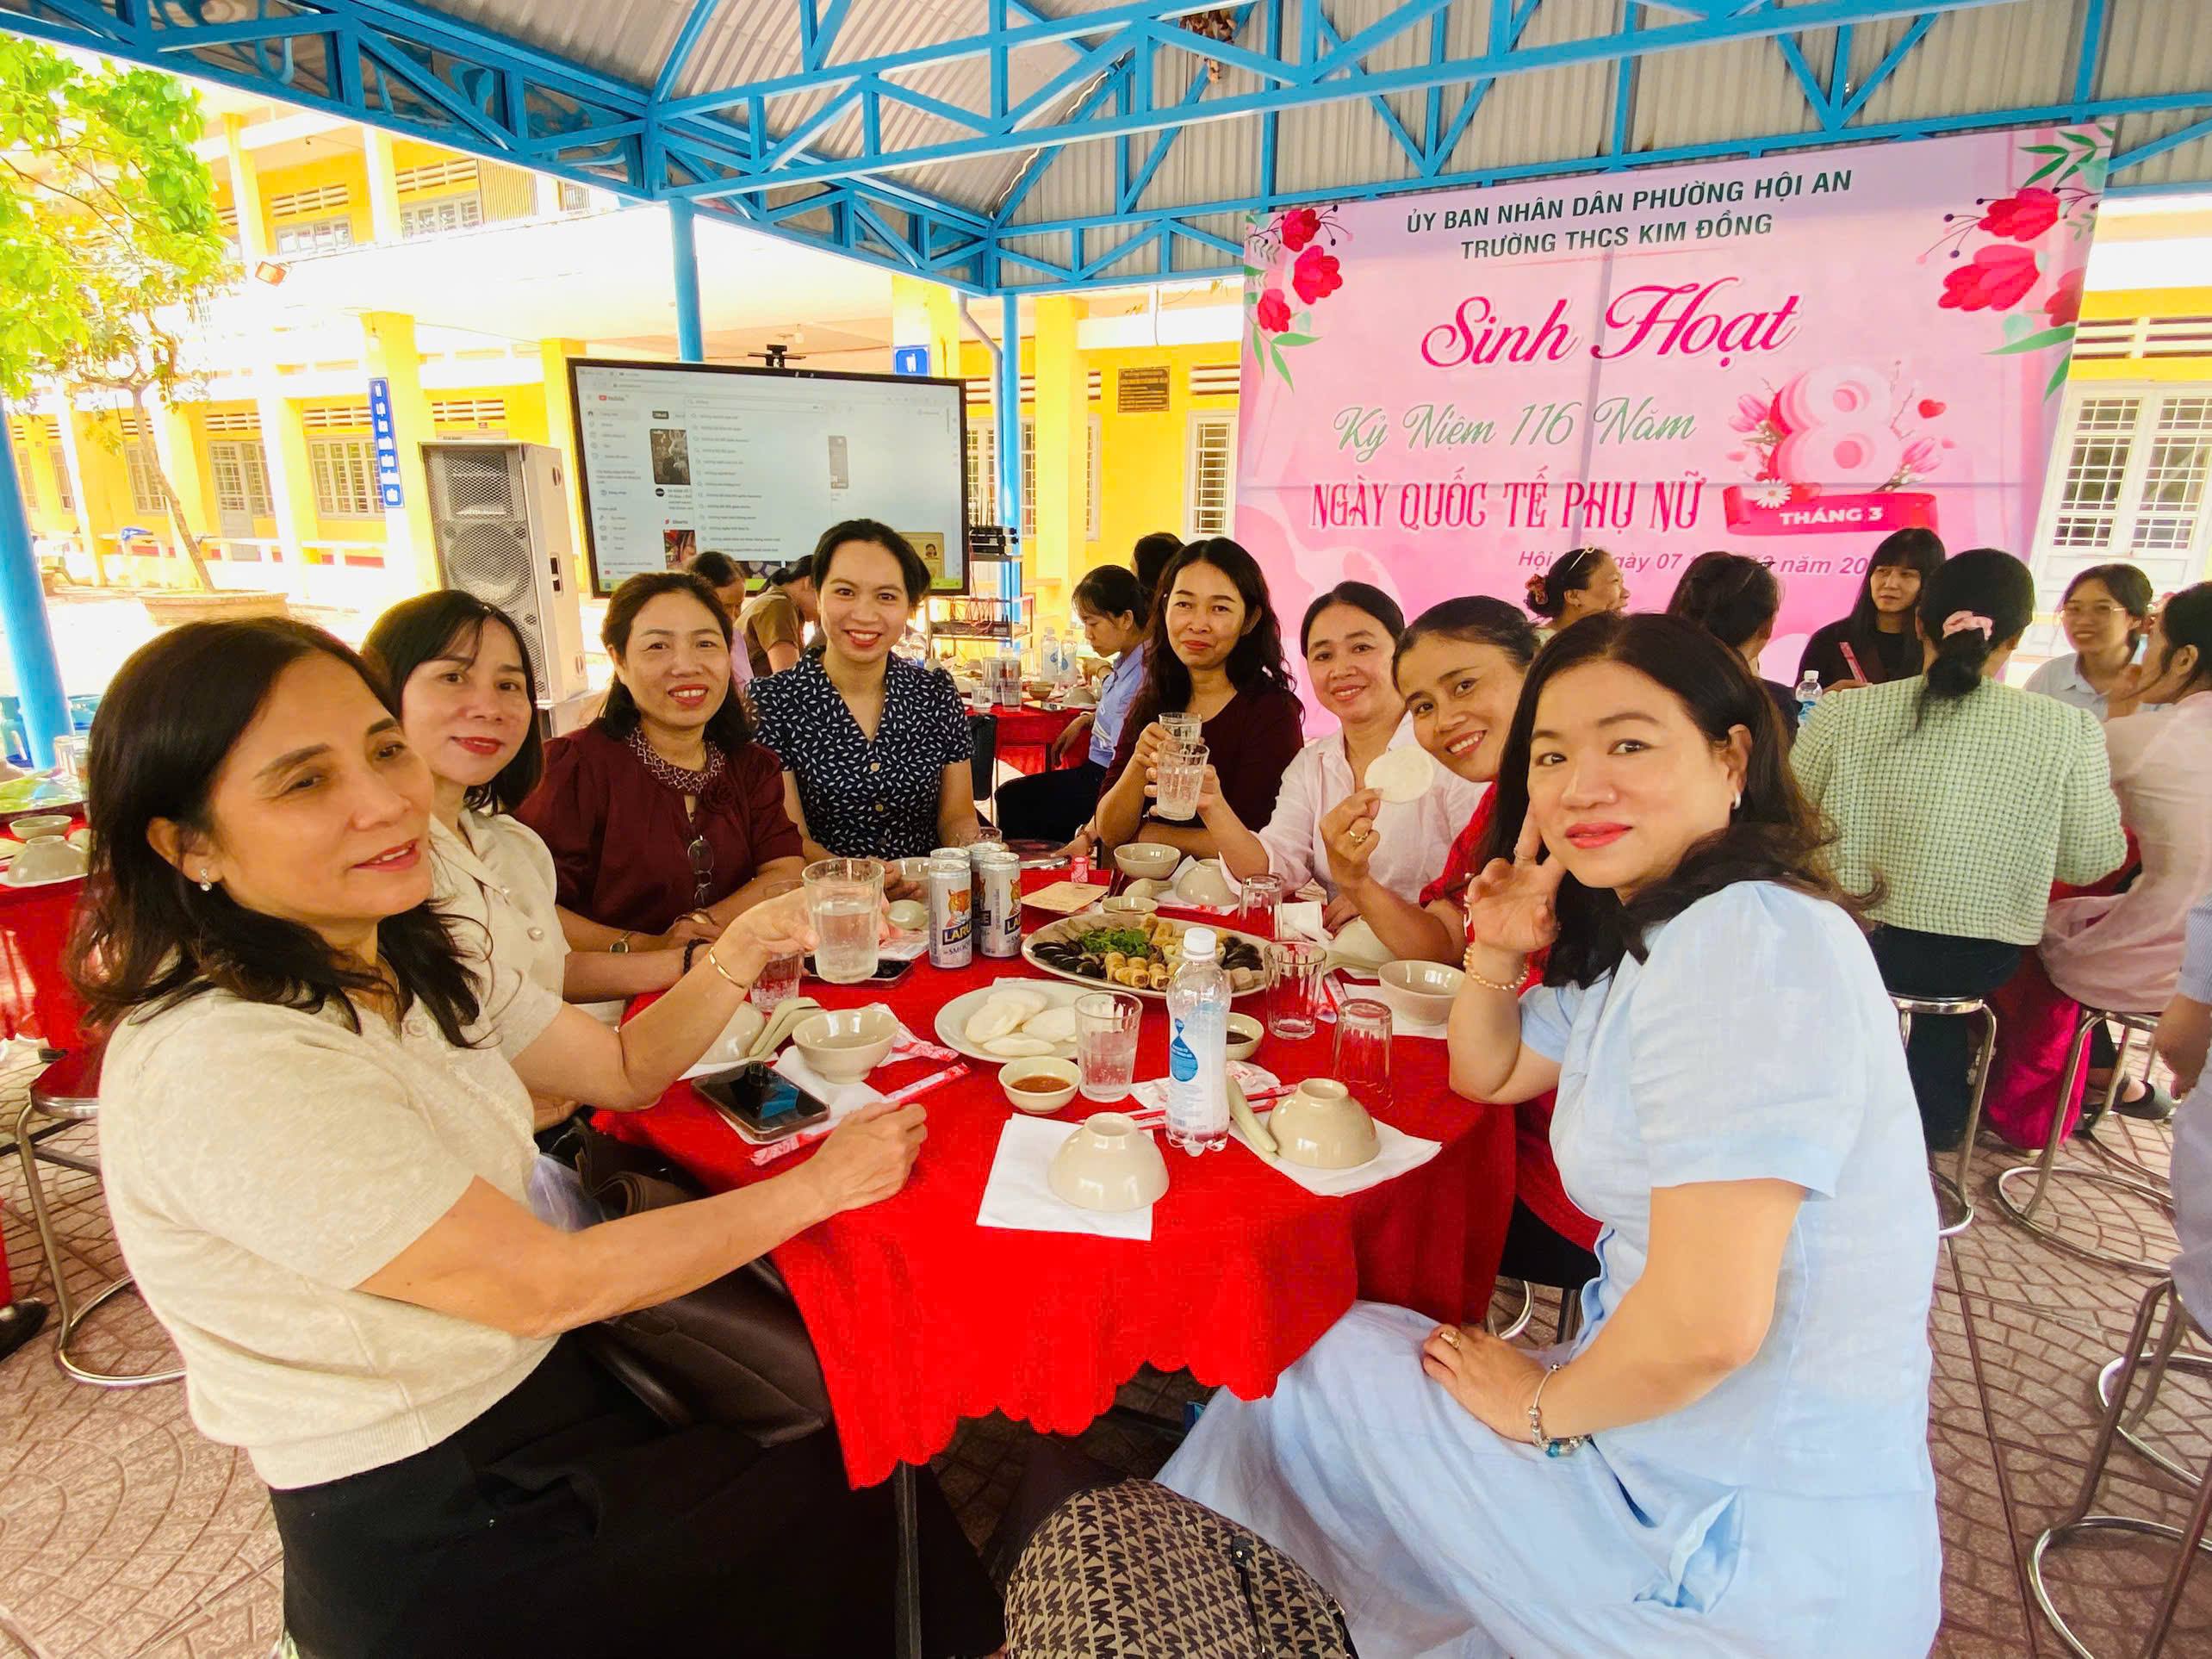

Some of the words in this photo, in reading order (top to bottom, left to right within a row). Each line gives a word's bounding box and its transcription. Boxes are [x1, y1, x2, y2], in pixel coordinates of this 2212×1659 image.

[1407, 208, 1437, 233] ỦY
[1444, 207, 1489, 229] BAN
[1497, 196, 1564, 224] NHÂN
[1572, 190, 1624, 216] DÂN
[1632, 180, 1743, 211] PHƯỜNG
[1754, 171, 1803, 202] HỘI
[1811, 170, 1853, 194] AN
[1461, 232, 1556, 260] TRƯỜNG
[1565, 227, 1630, 250] THCS
[1638, 221, 1687, 245] KIM
[1695, 210, 1773, 239] ĐỒNG
[1420, 295, 1579, 368] Sinh
[1590, 276, 1801, 368] Hoạt
[1333, 407, 1389, 463] Kỷ
[1402, 403, 1497, 450] Niệm
[1509, 401, 1582, 447] 116
[1592, 396, 1697, 446] Năm
[1311, 473, 1390, 531] NGÀY
[1399, 465, 1489, 531] QUỐC
[1502, 465, 1550, 528] TẾ
[1560, 482, 1638, 535] PHỤ
[1650, 470, 1708, 532] NỮ
[1779, 506, 1862, 525] THÁNG
[1864, 506, 1884, 521] 3
[1518, 550, 1553, 570] Hội
[1613, 551, 1651, 573] gày
[1656, 553, 1683, 569] 07
[1779, 556, 1831, 574] năm
[1839, 556, 1869, 575] 20
[944, 925, 972, 942] LARU
